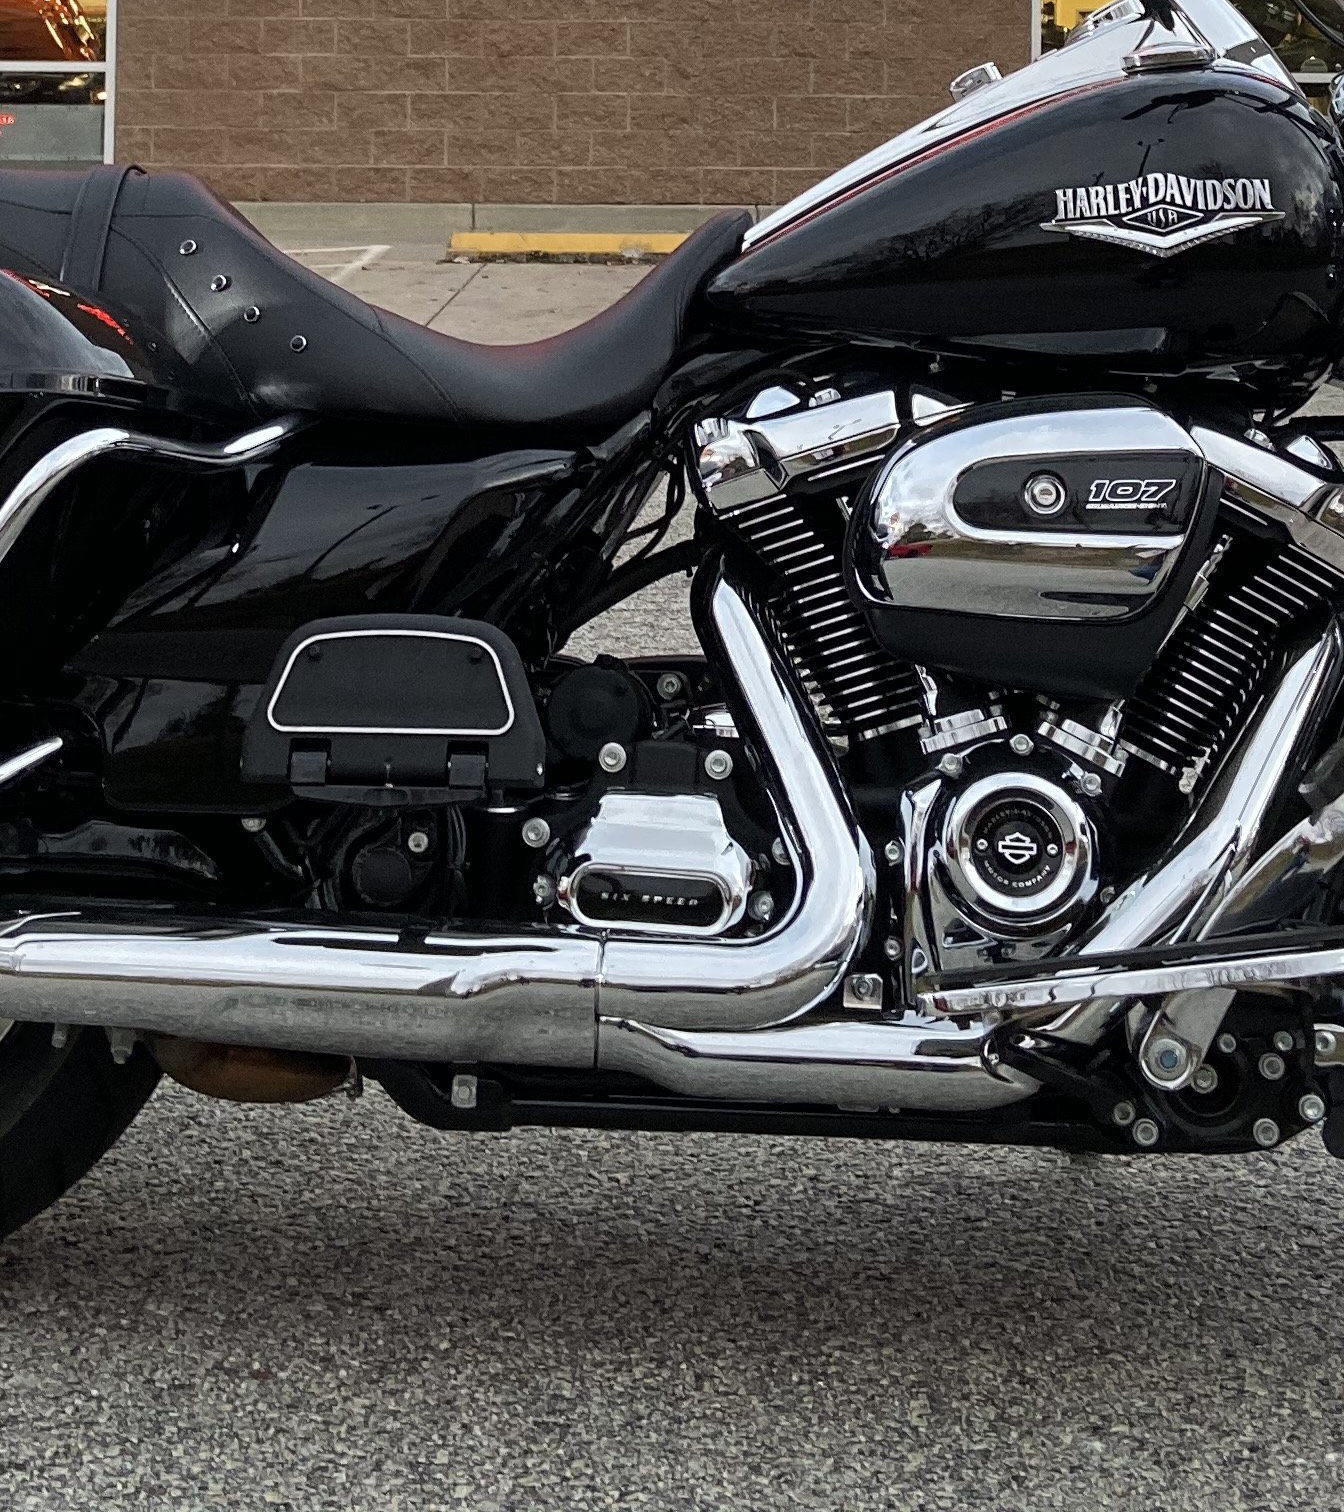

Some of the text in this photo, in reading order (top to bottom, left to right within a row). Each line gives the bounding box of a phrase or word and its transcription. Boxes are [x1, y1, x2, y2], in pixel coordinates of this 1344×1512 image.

[1052, 172, 1275, 223] HARLEY-DAVIDSON
[1146, 208, 1178, 228] USA
[1088, 478, 1177, 502] 107
[600, 891, 699, 906] SIX SPEED
